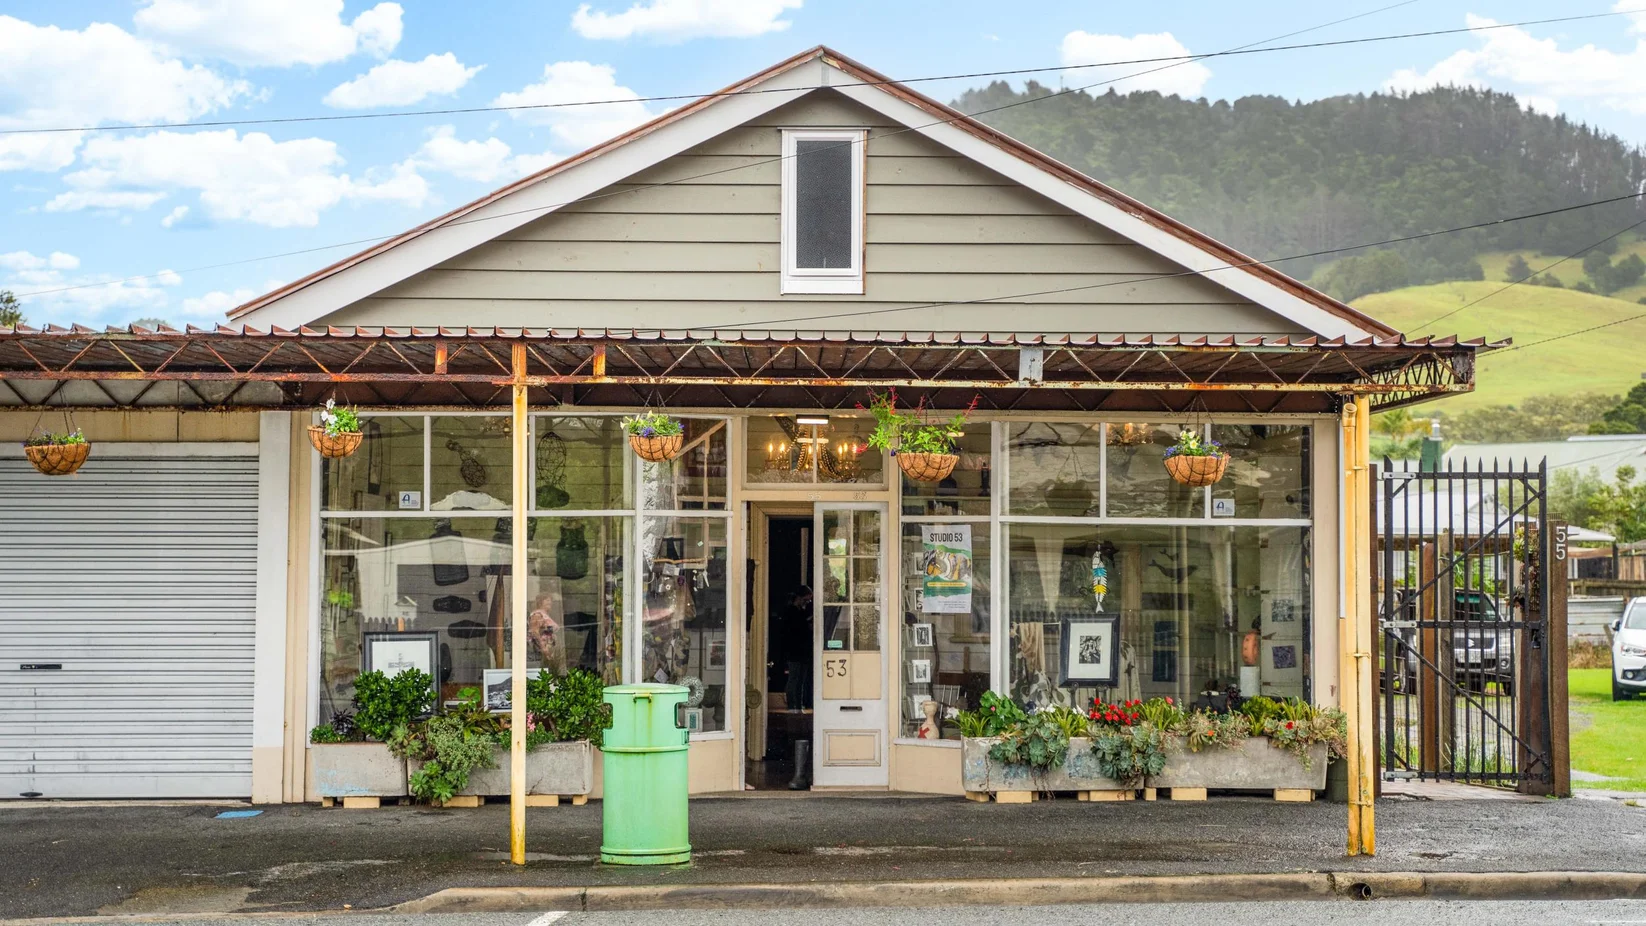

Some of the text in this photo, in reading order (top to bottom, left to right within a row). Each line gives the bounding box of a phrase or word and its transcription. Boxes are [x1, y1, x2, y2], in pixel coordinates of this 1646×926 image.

[929, 532, 963, 543] STUDIO 53
[1556, 526, 1566, 560] 55
[826, 659, 847, 678] 53
